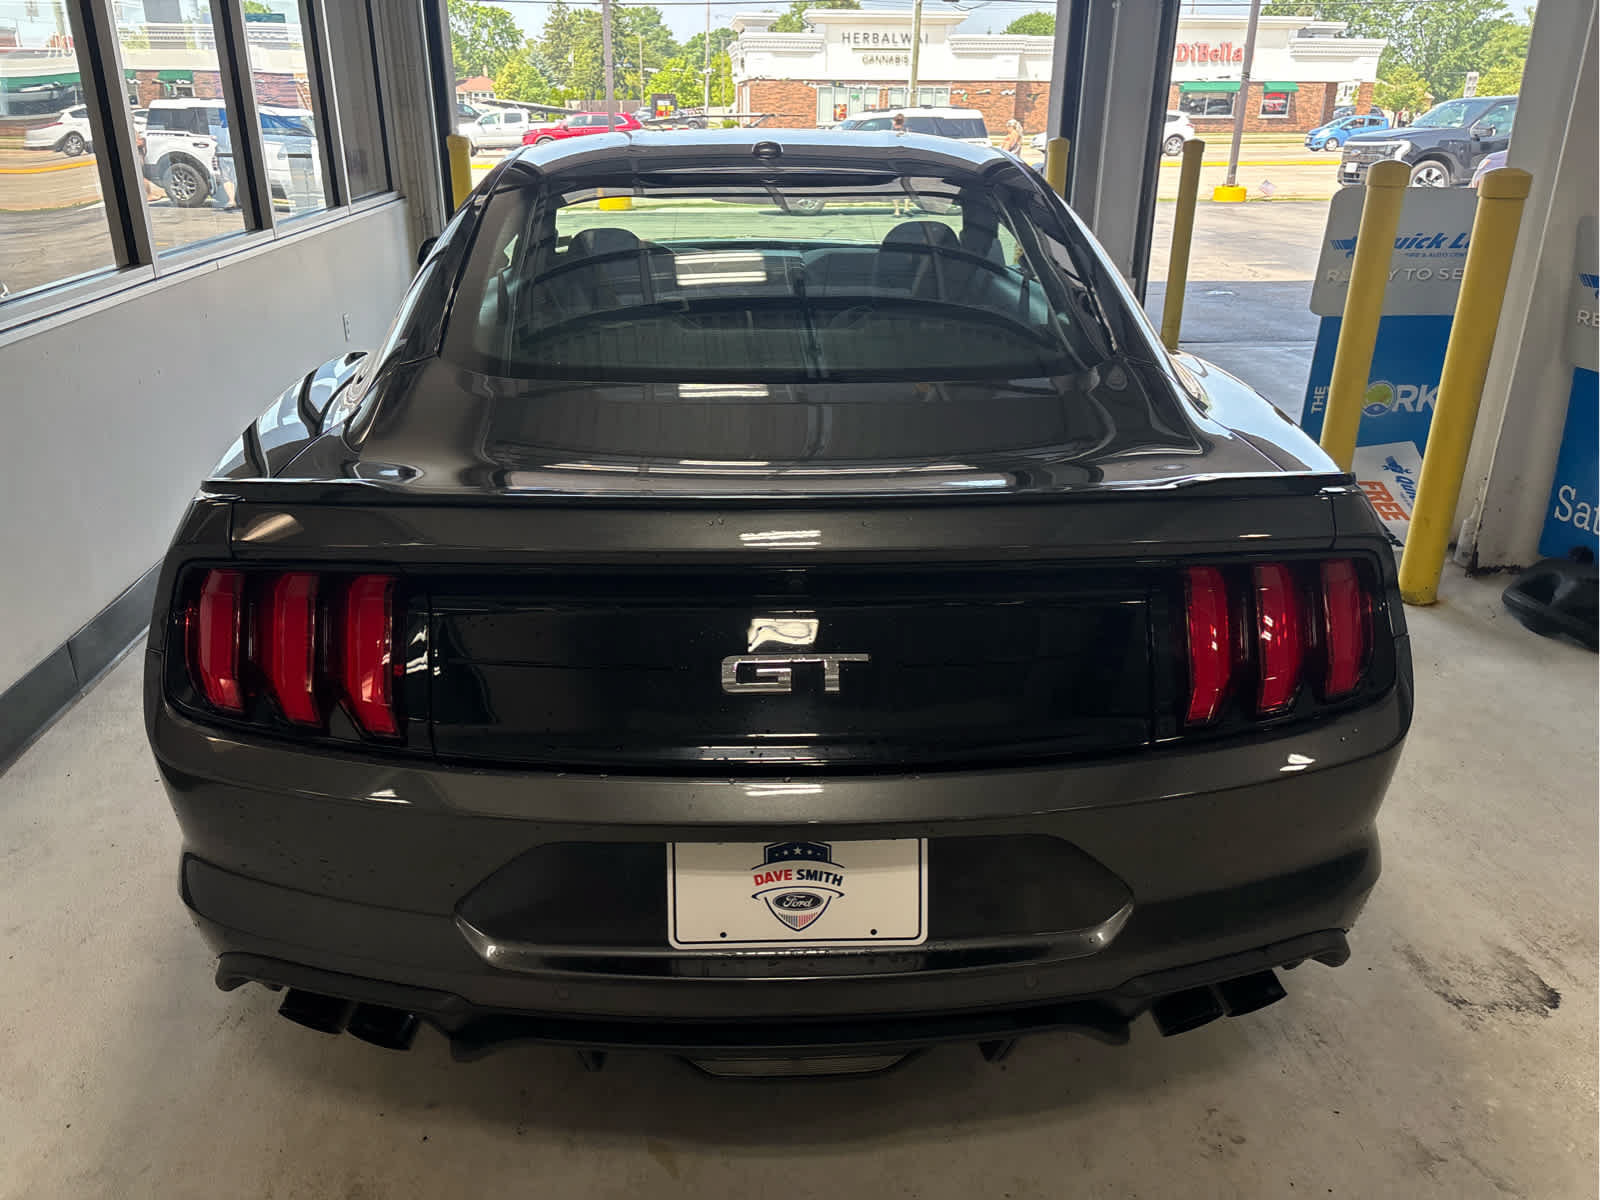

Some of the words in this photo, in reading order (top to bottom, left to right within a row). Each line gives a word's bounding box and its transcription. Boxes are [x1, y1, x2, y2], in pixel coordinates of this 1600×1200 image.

[862, 55, 909, 64] CANNABIS
[1176, 42, 1244, 62] DiBella
[1394, 232, 1448, 249] uick
[1404, 267, 1433, 281] TO
[1310, 386, 1328, 415] THE
[1357, 481, 1411, 521] FREE
[721, 653, 870, 693] GT
[753, 869, 793, 887] DAVE
[796, 869, 843, 887] SMITH
[782, 894, 814, 908] Ford
